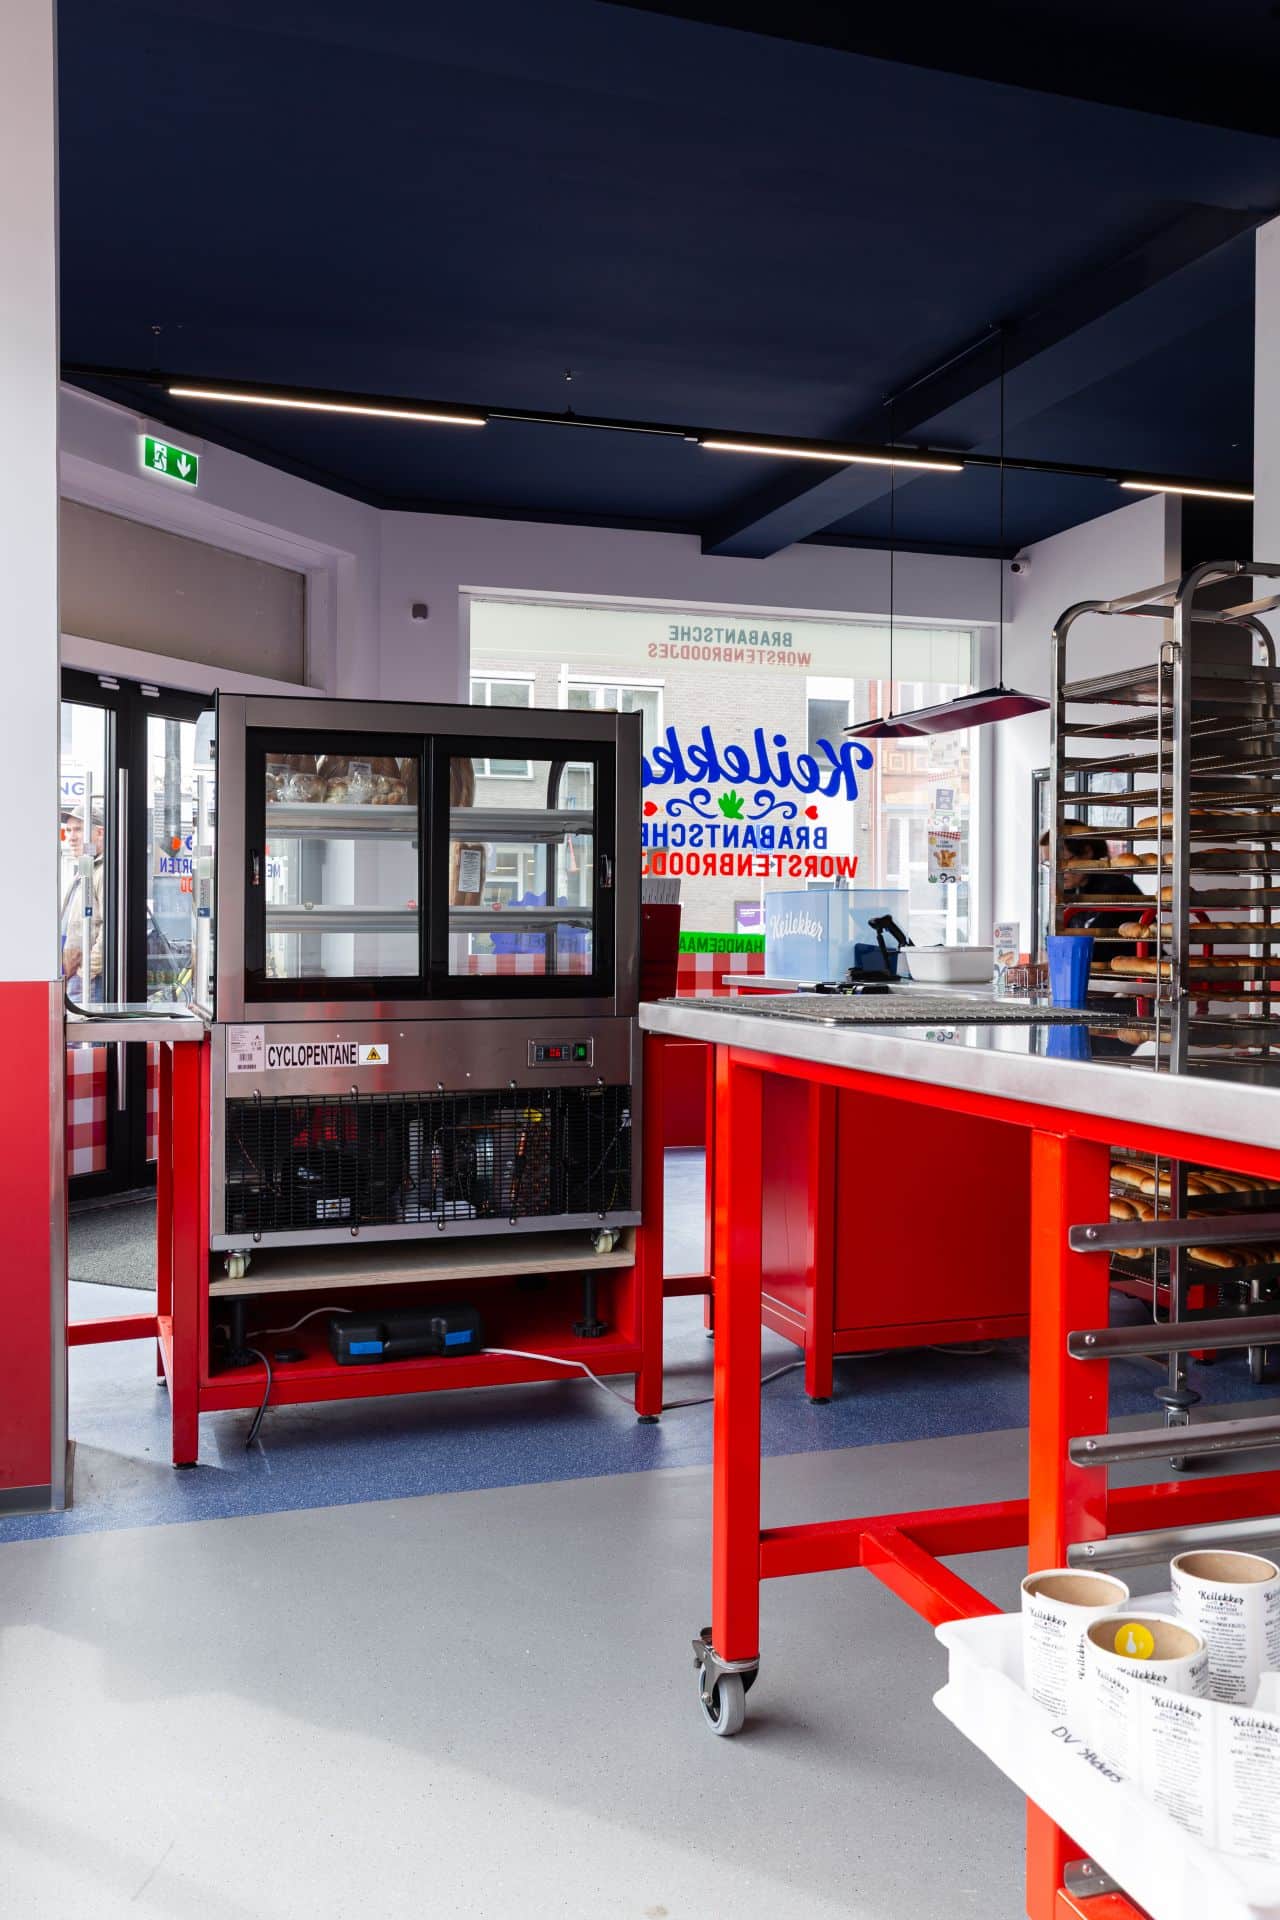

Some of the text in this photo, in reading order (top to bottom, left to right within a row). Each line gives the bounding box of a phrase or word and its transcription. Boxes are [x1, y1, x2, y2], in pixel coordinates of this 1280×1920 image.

[771, 910, 824, 942] Keilekker
[268, 1044, 357, 1067] CYCLOPENTANE
[1198, 1590, 1244, 1605] Keilekker
[1151, 1695, 1202, 1720] Keilekker
[1051, 1726, 1081, 1743] DV
